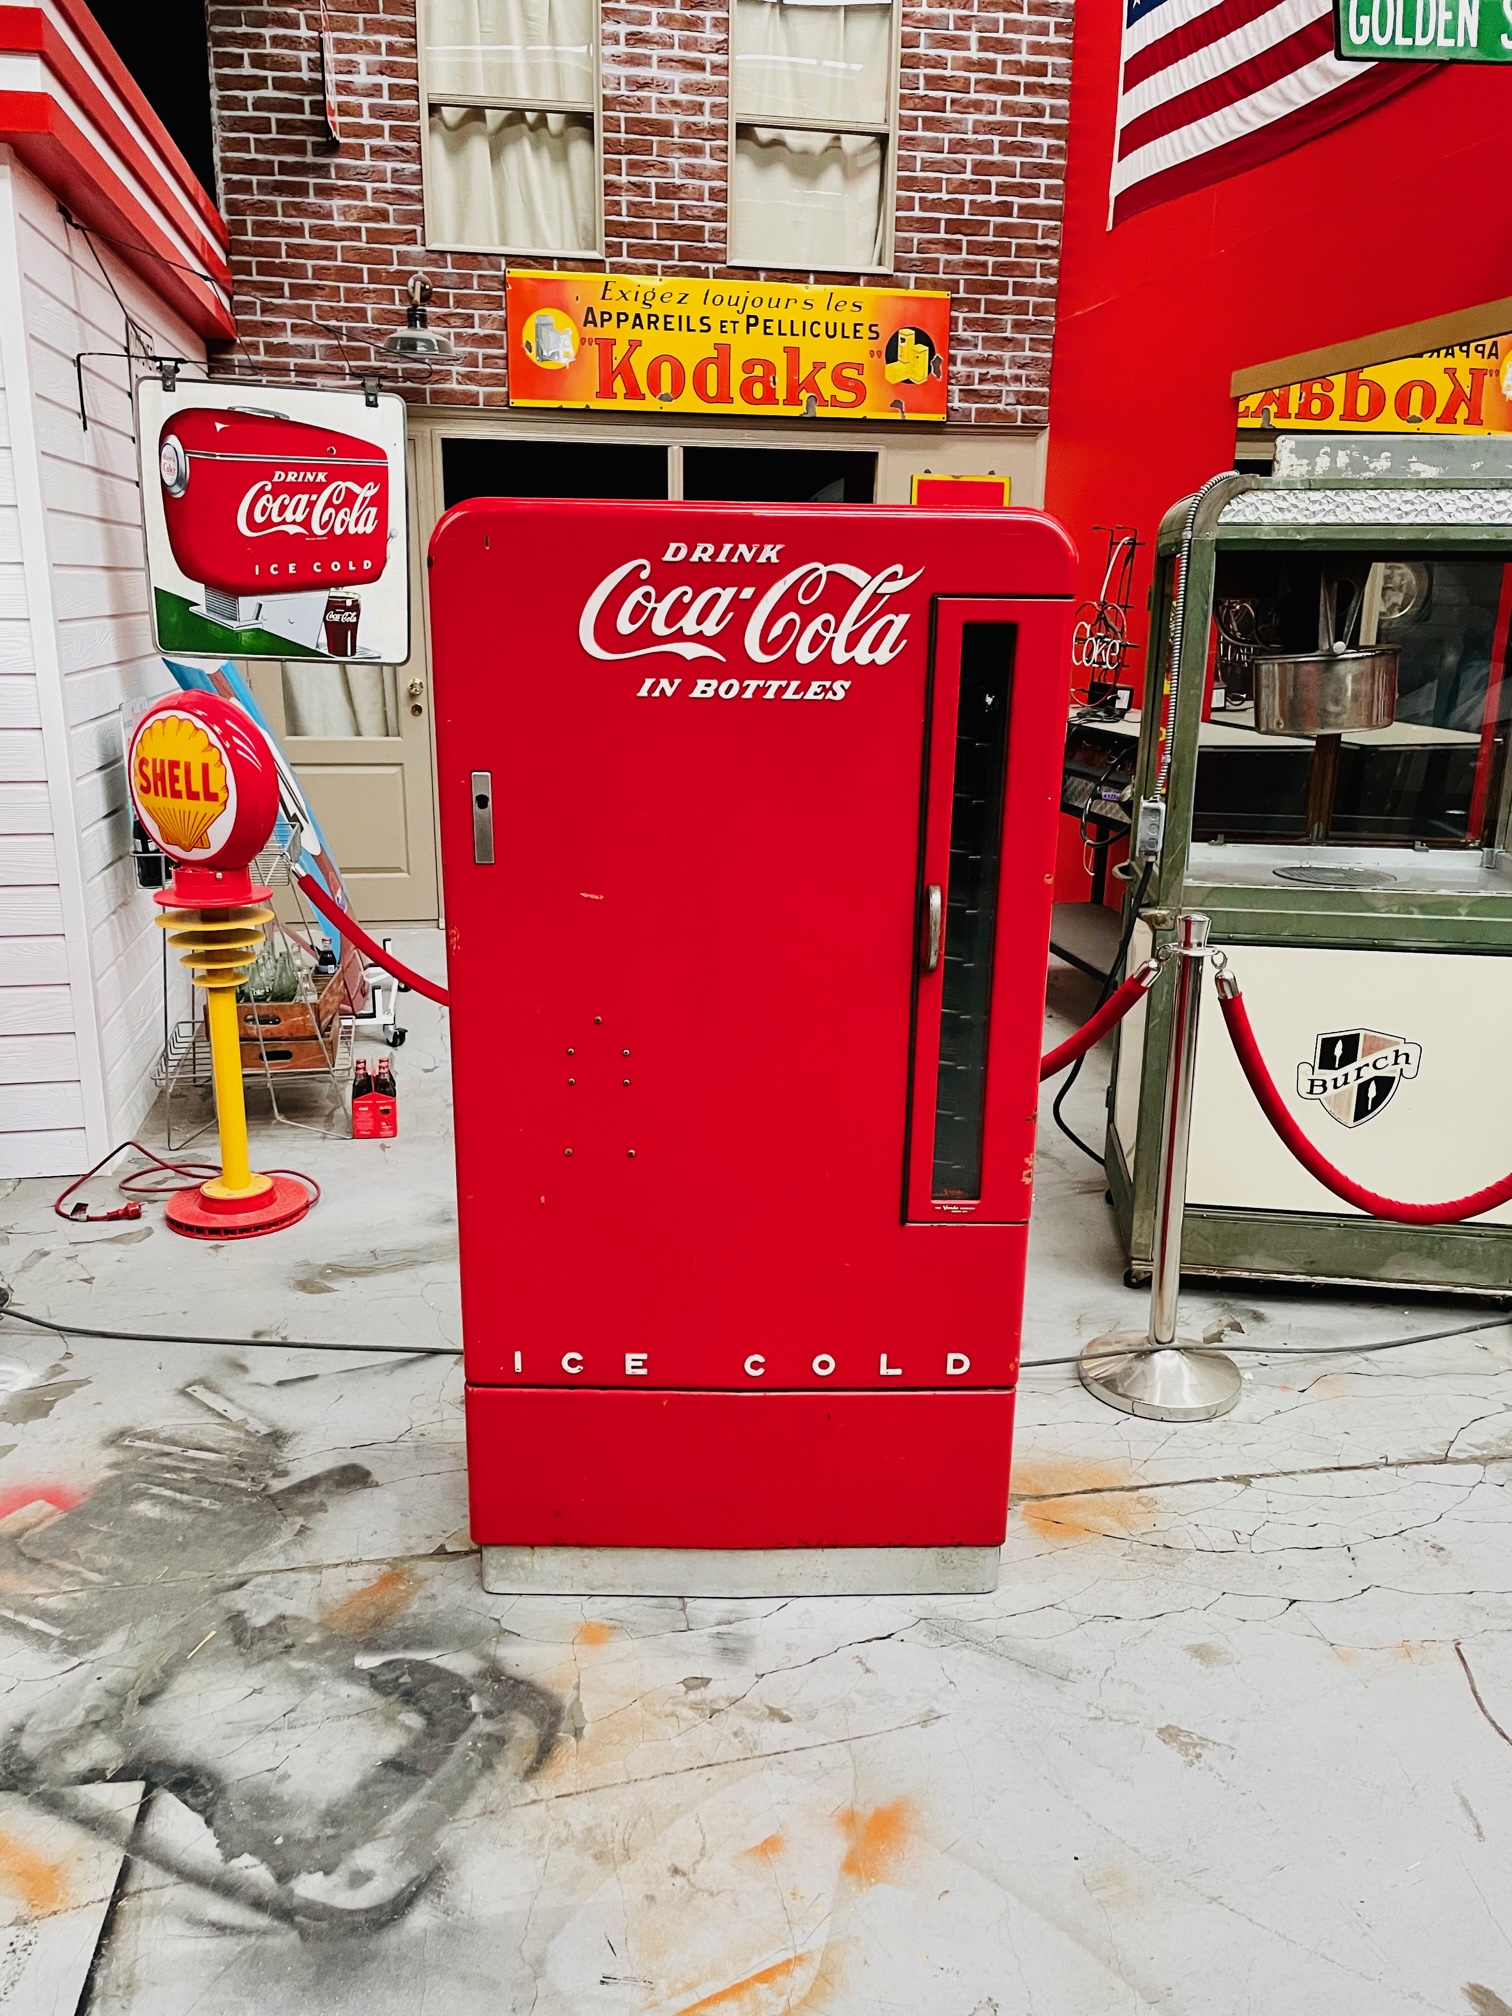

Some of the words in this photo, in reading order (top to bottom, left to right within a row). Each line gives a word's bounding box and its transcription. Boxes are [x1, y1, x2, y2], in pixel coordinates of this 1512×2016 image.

[1348, 0, 1480, 48] GOLDEN
[600, 280, 690, 310] Exigez
[826, 291, 864, 314] les
[582, 306, 712, 334] APPAREILS
[720, 319, 739, 335] ET
[745, 317, 880, 341] PELLICULES
[271, 470, 329, 483] DRINK
[236, 480, 381, 538] Coca-Cola
[254, 562, 297, 576] ICE
[313, 559, 373, 573] COLD
[661, 542, 786, 564] DRINK
[578, 558, 926, 666] Coca-Cola
[1072, 620, 1121, 671] Coke
[636, 677, 683, 699] IN
[688, 678, 852, 701] BOTTLES
[138, 755, 220, 803] SHELL
[1305, 1048, 1412, 1096] Burch
[513, 1350, 649, 1375] ICE
[743, 1352, 972, 1376] COLD
